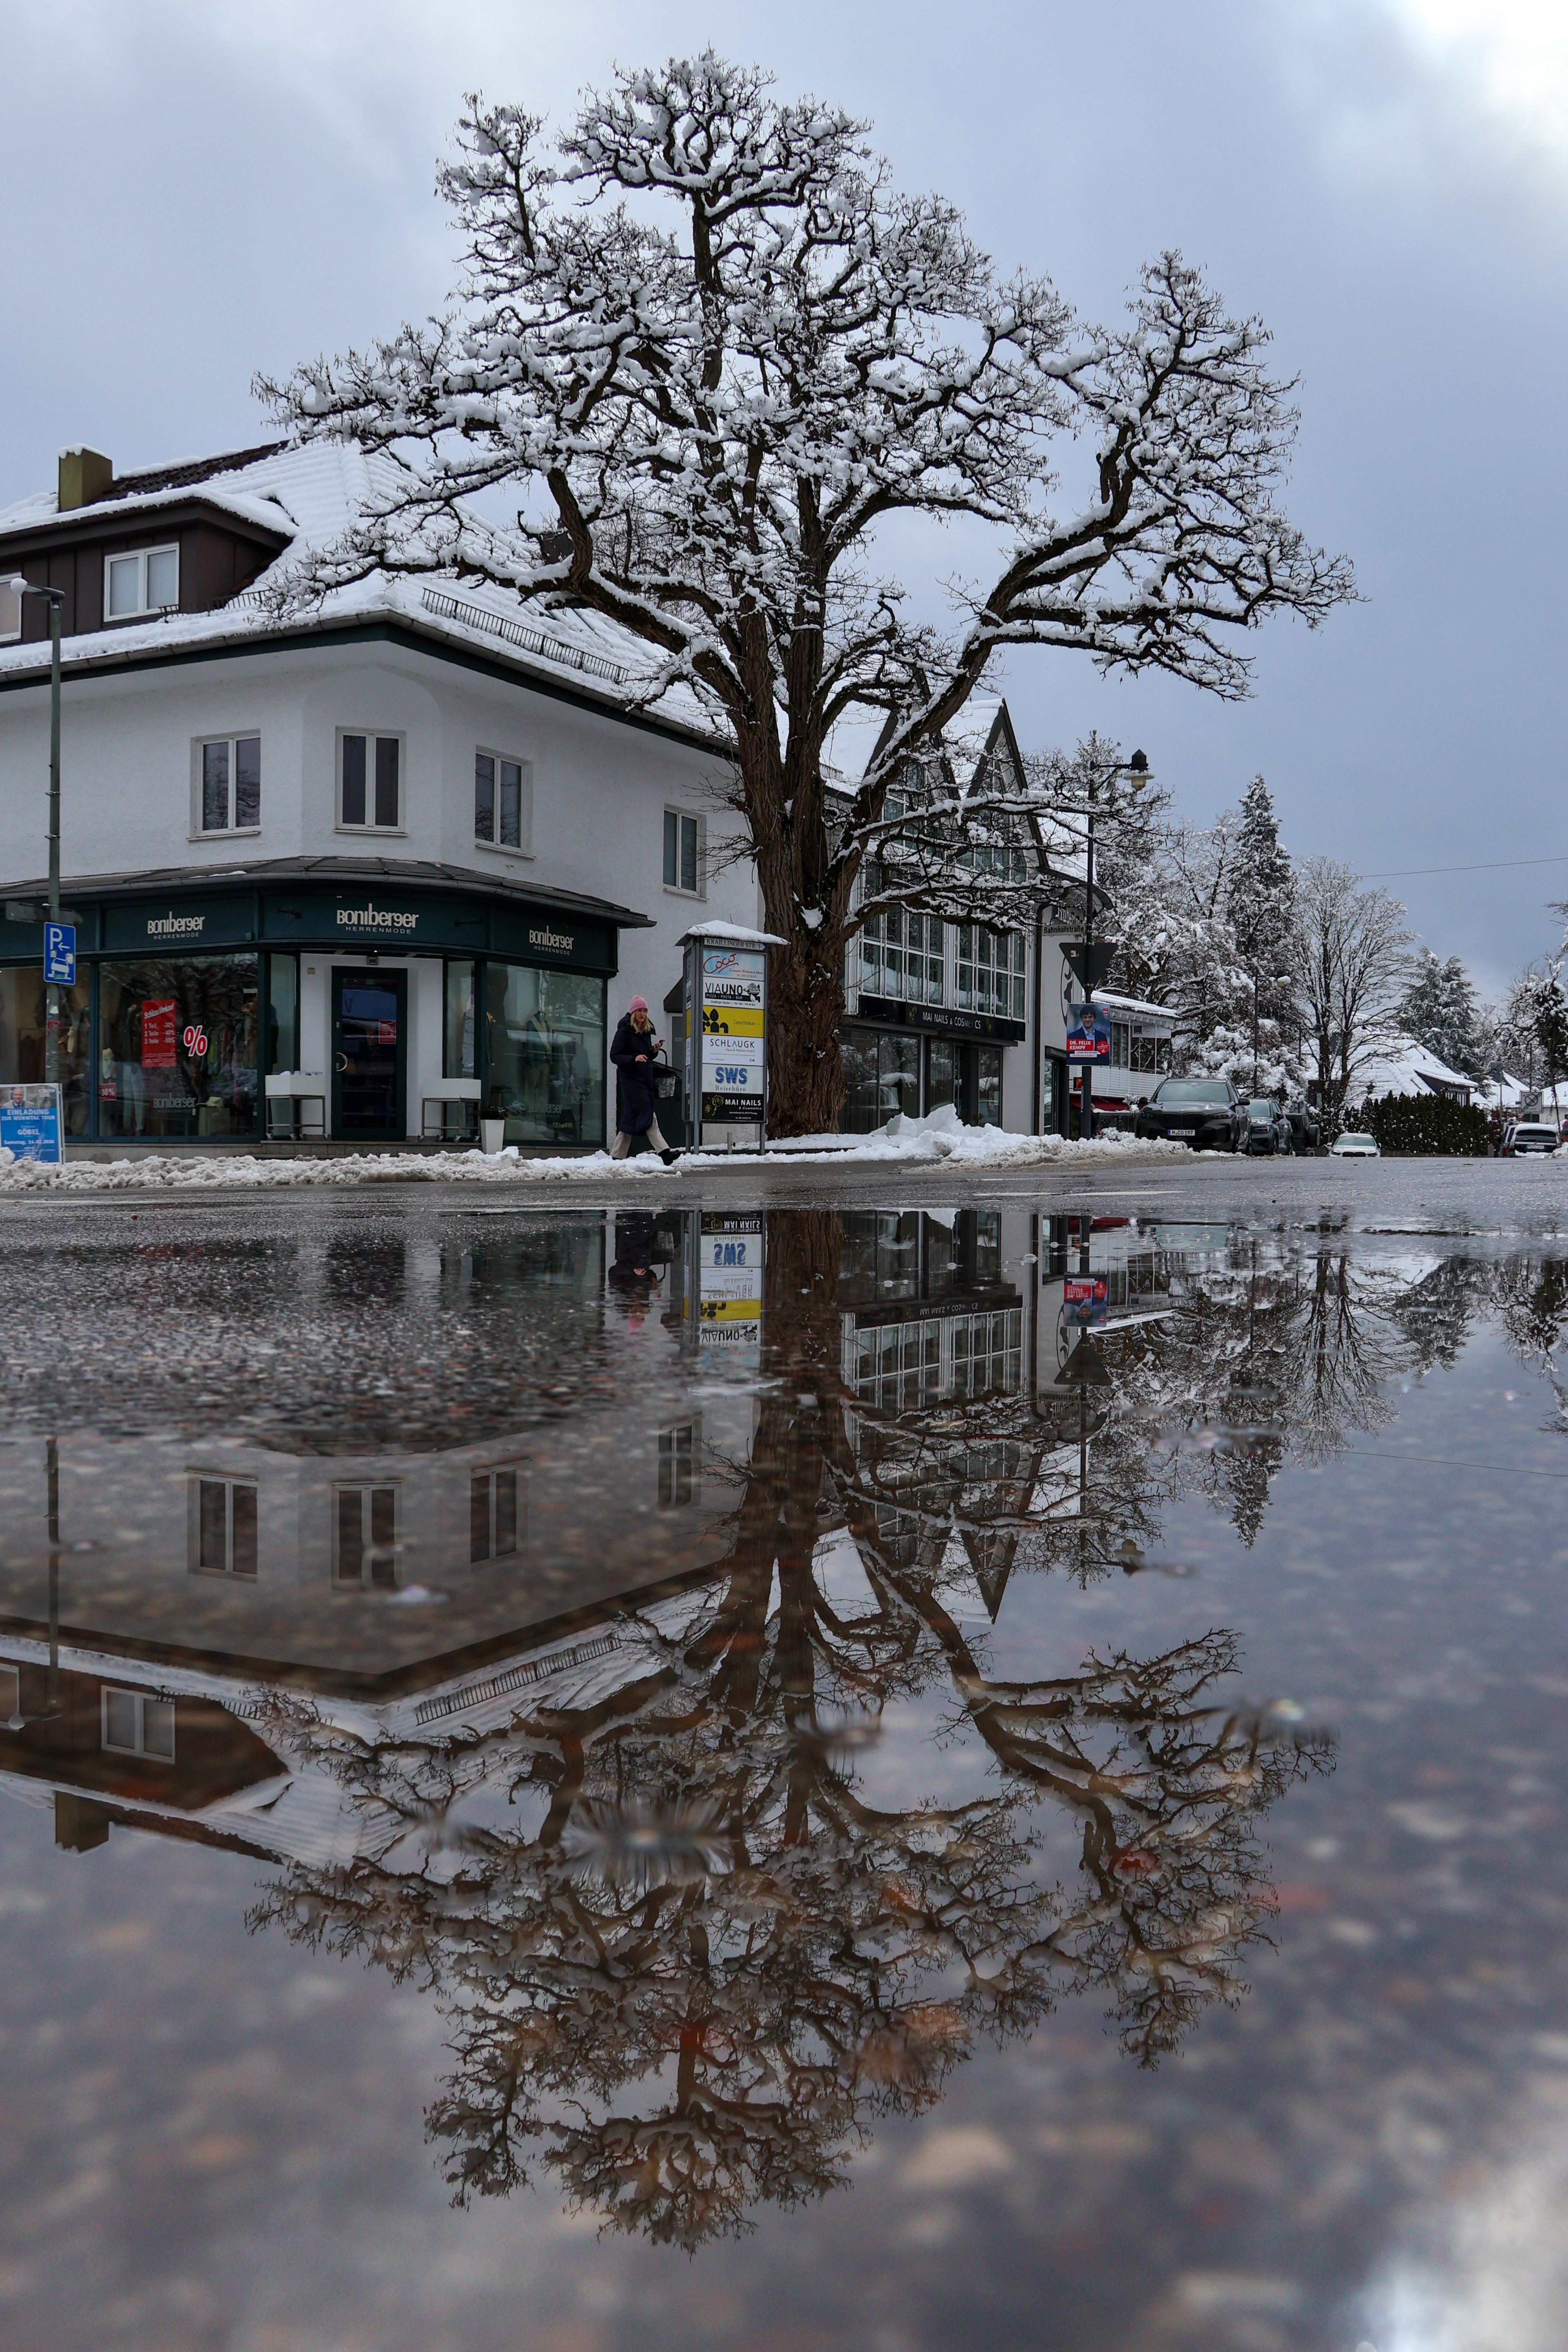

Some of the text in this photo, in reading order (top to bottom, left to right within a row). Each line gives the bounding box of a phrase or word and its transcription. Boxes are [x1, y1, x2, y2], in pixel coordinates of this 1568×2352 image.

[1044, 925, 1084, 933] Bahnhofstraße
[50, 928, 62, 949] P
[707, 939, 744, 947] KRAILLINGER
[534, 946, 570, 956] HERRENMODE
[923, 1011, 933, 1021] MAI
[934, 1014, 948, 1024] NAILS
[710, 1039, 755, 1049] SCHLAUGK
[715, 1067, 748, 1084] SWS
